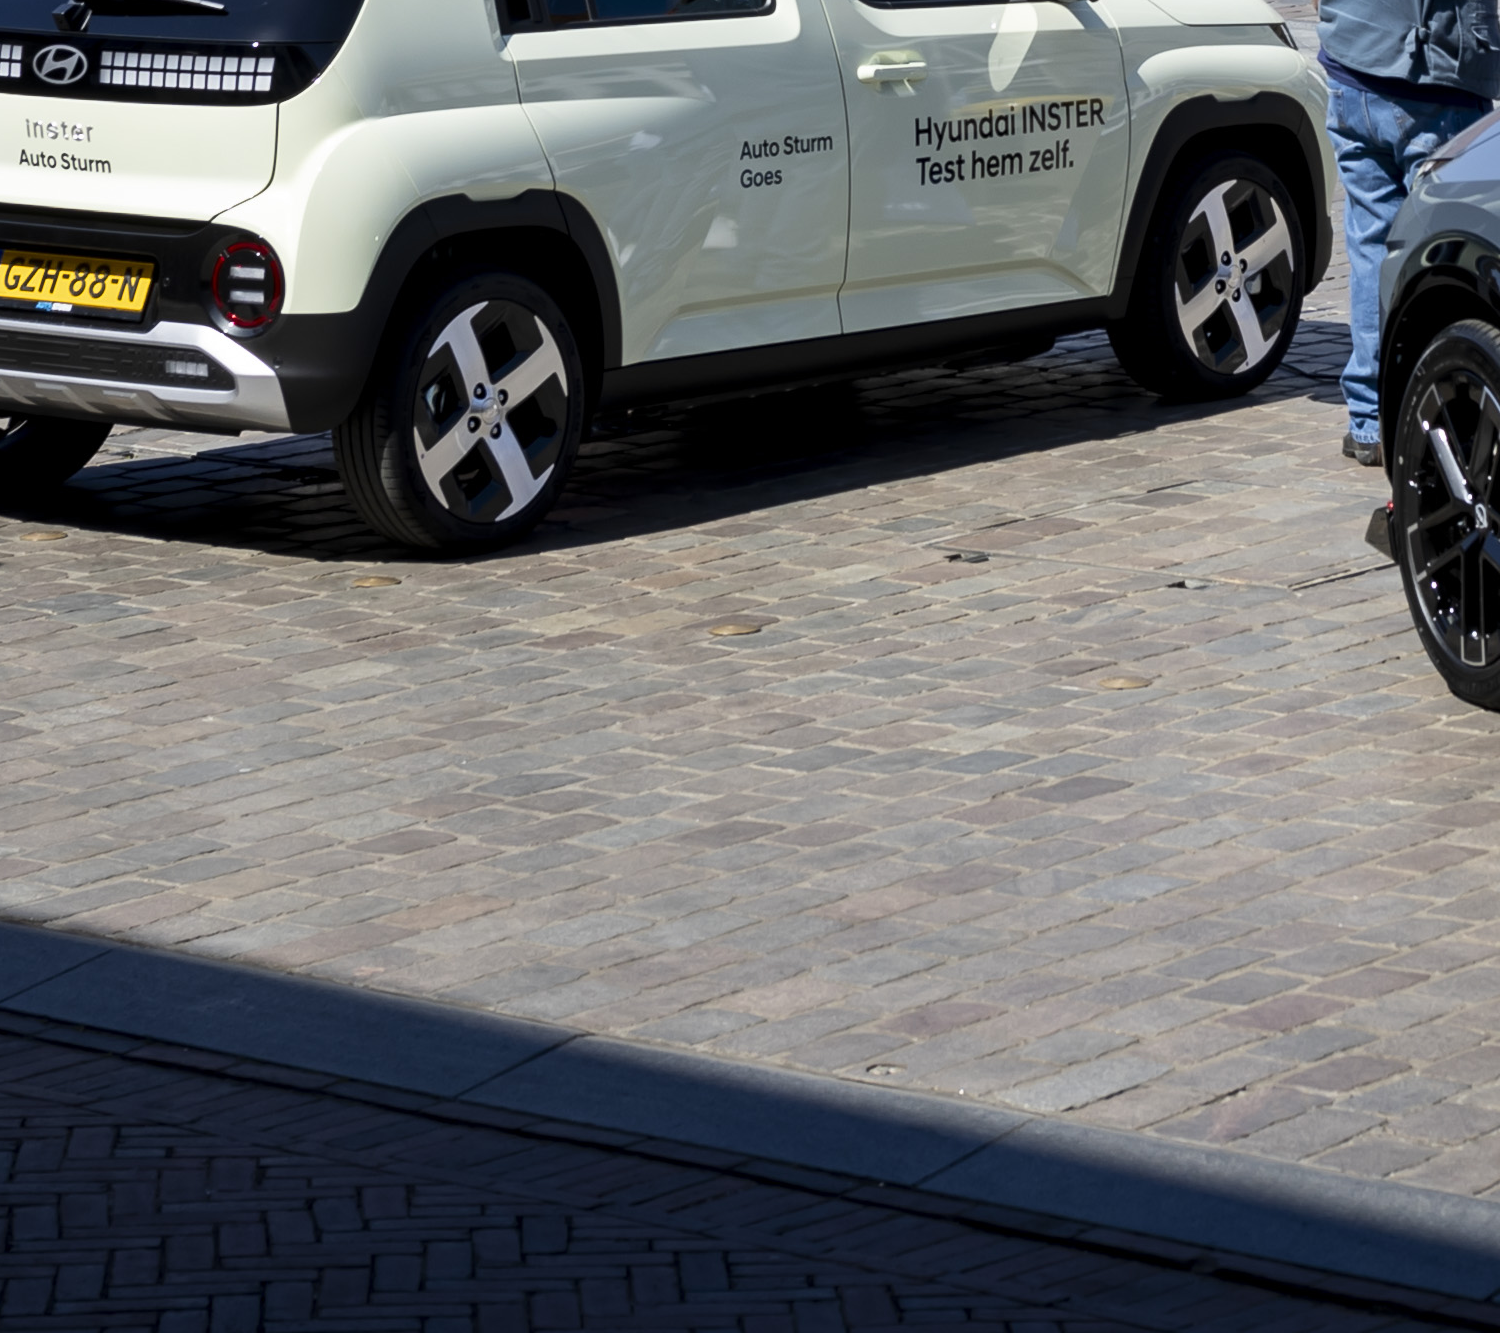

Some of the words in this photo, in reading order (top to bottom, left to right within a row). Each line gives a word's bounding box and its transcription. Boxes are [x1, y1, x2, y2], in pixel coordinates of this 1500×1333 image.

[25, 118, 94, 142] inster
[914, 106, 1016, 151] Hyundai
[1022, 97, 1105, 134] INSTER
[19, 149, 57, 169] Auto
[61, 152, 112, 173] Sturm
[739, 141, 780, 161] Auto
[783, 135, 833, 156] Sturm
[916, 156, 965, 186] Test
[971, 150, 1023, 180] hem
[1028, 139, 1074, 172] zelf.
[740, 167, 783, 188] Goes
[4, 257, 143, 302] GZH-88-N
